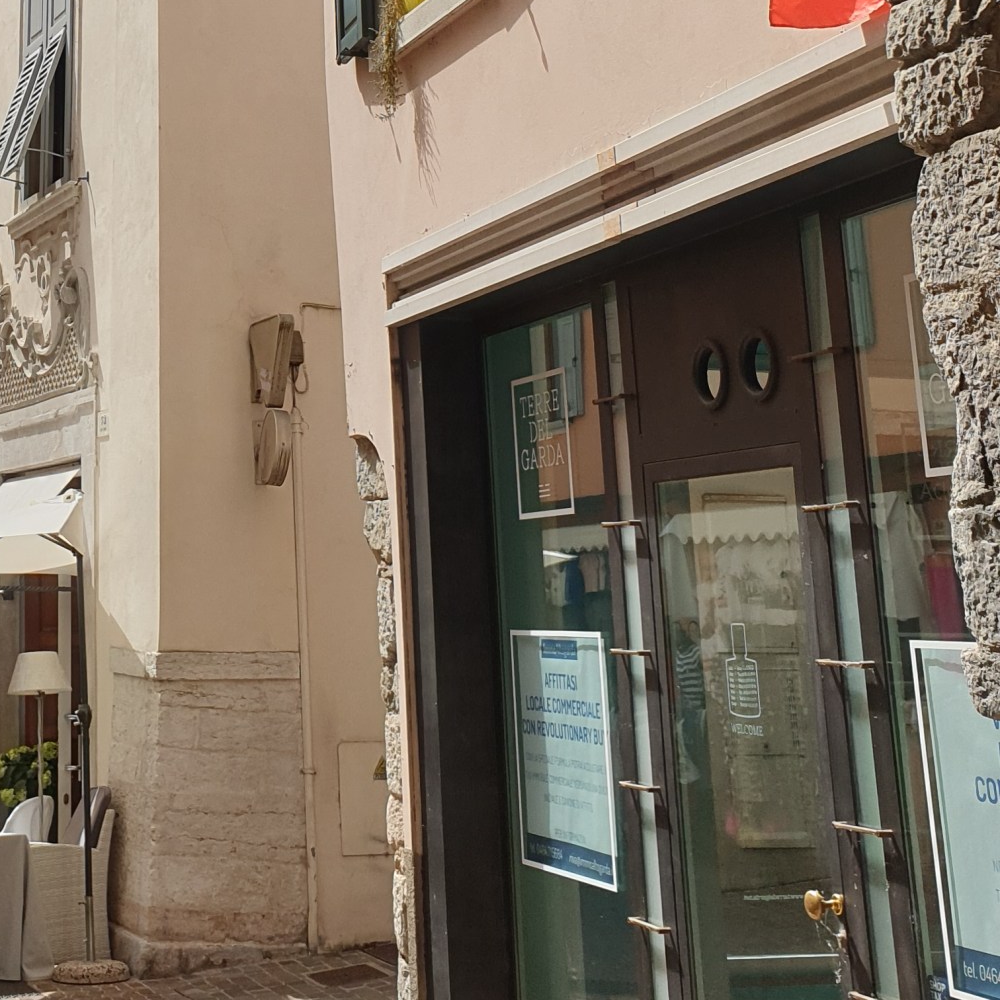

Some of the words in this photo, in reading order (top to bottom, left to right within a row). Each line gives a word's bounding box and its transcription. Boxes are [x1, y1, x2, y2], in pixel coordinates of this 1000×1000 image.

[519, 388, 560, 419] TERRE
[529, 417, 553, 443] DEL
[521, 442, 565, 471] GARDA
[544, 672, 578, 691] AFFITTASI
[525, 694, 552, 713] LOCALE
[552, 698, 601, 720] COMMERCIALE
[522, 718, 536, 735] CON
[537, 720, 592, 744] REVOLUTIONARY
[593, 728, 605, 746] BU
[730, 722, 764, 737] WELCOME
[963, 960, 978, 979] tel.
